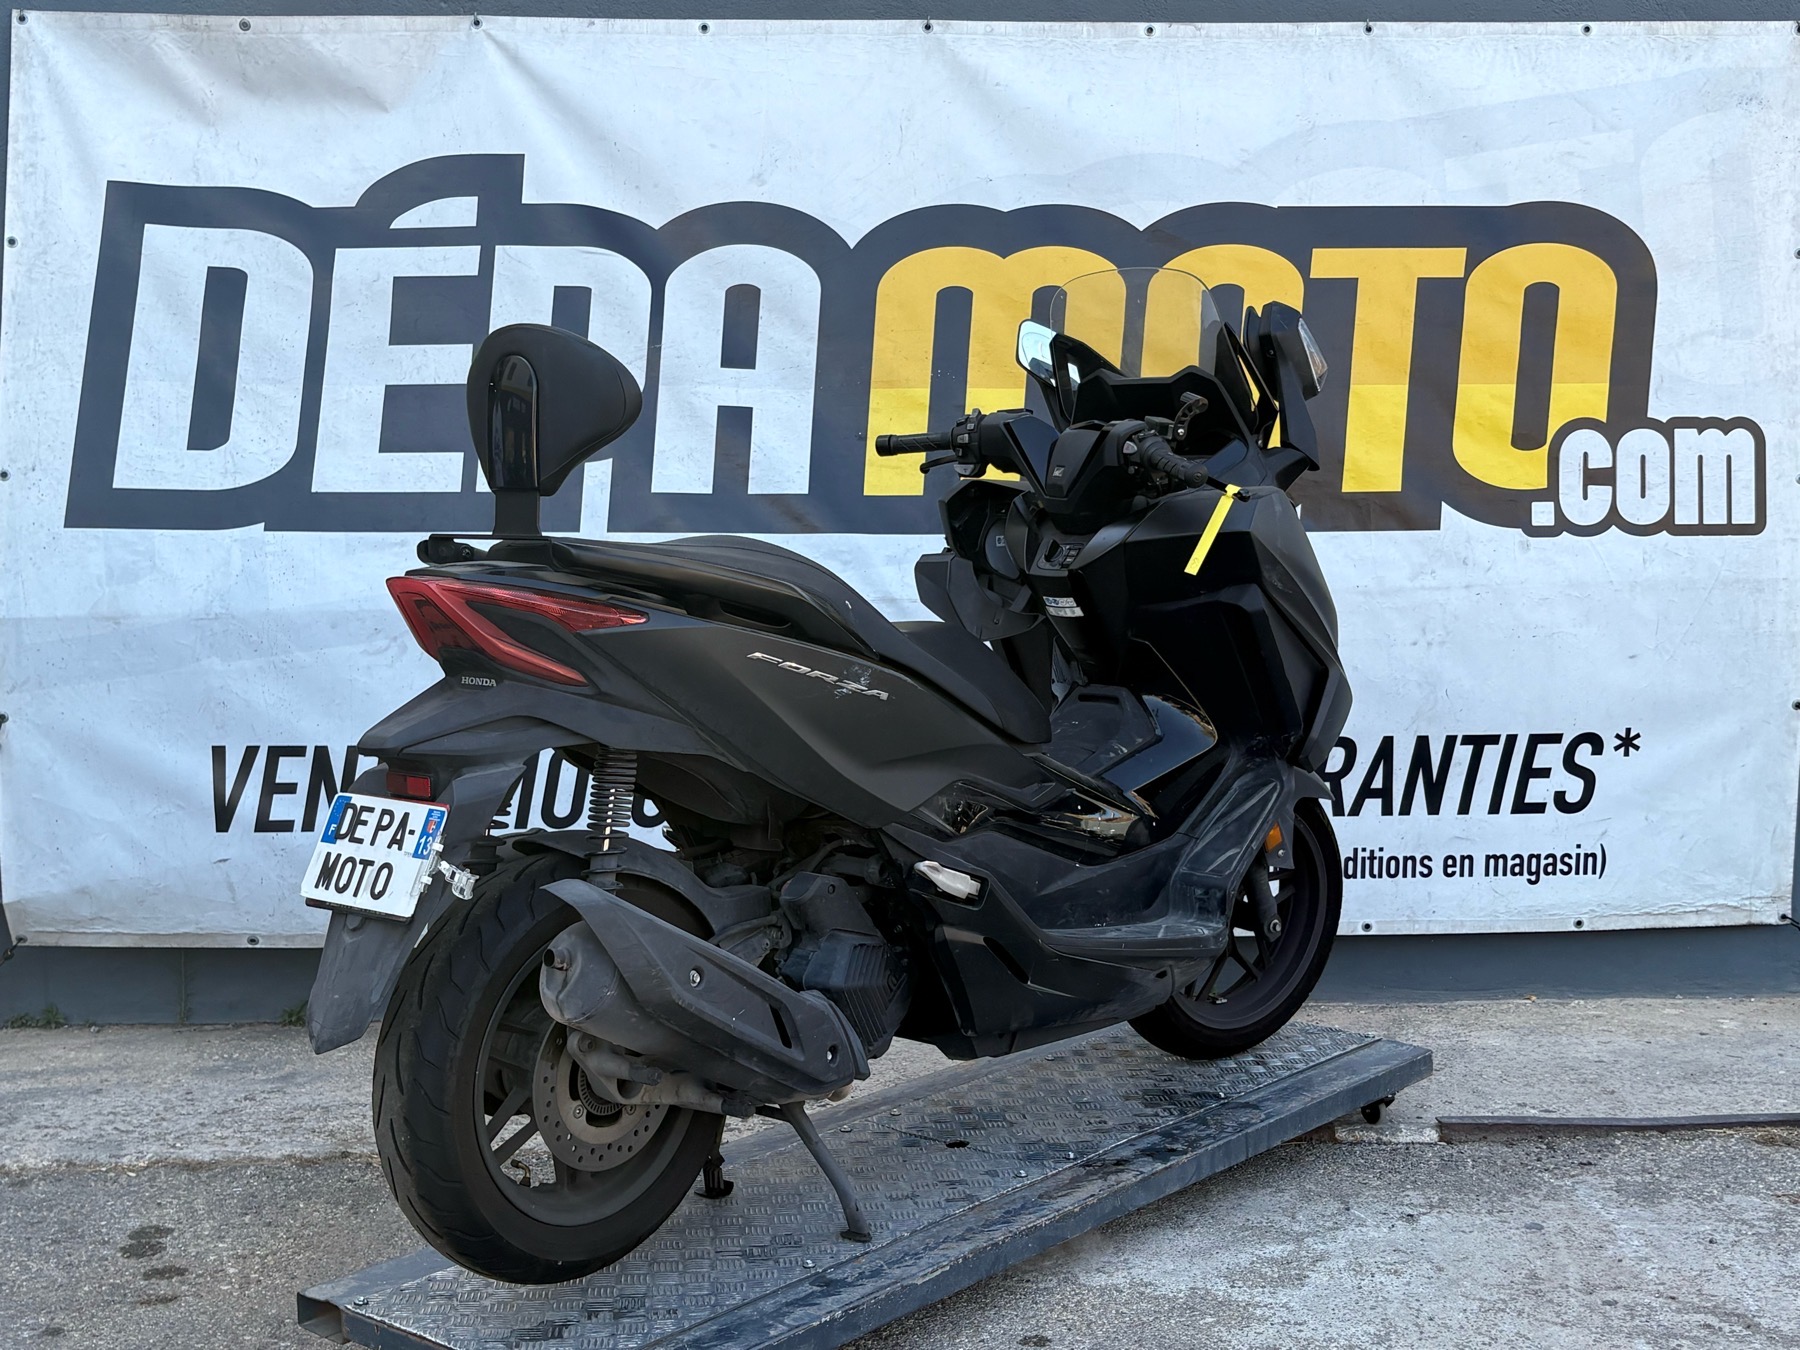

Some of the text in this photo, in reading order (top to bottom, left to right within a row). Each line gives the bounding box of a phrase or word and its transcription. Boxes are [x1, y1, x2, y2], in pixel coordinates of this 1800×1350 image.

[1531, 427, 1758, 528] .com
[461, 676, 497, 687] HONDA
[210, 745, 359, 833] VEN
[1320, 727, 1642, 818] RANTIES
[328, 823, 337, 836] F
[417, 835, 433, 856] 13
[314, 851, 394, 901] MOTO
[1343, 844, 1608, 885] ditions en magasin)
